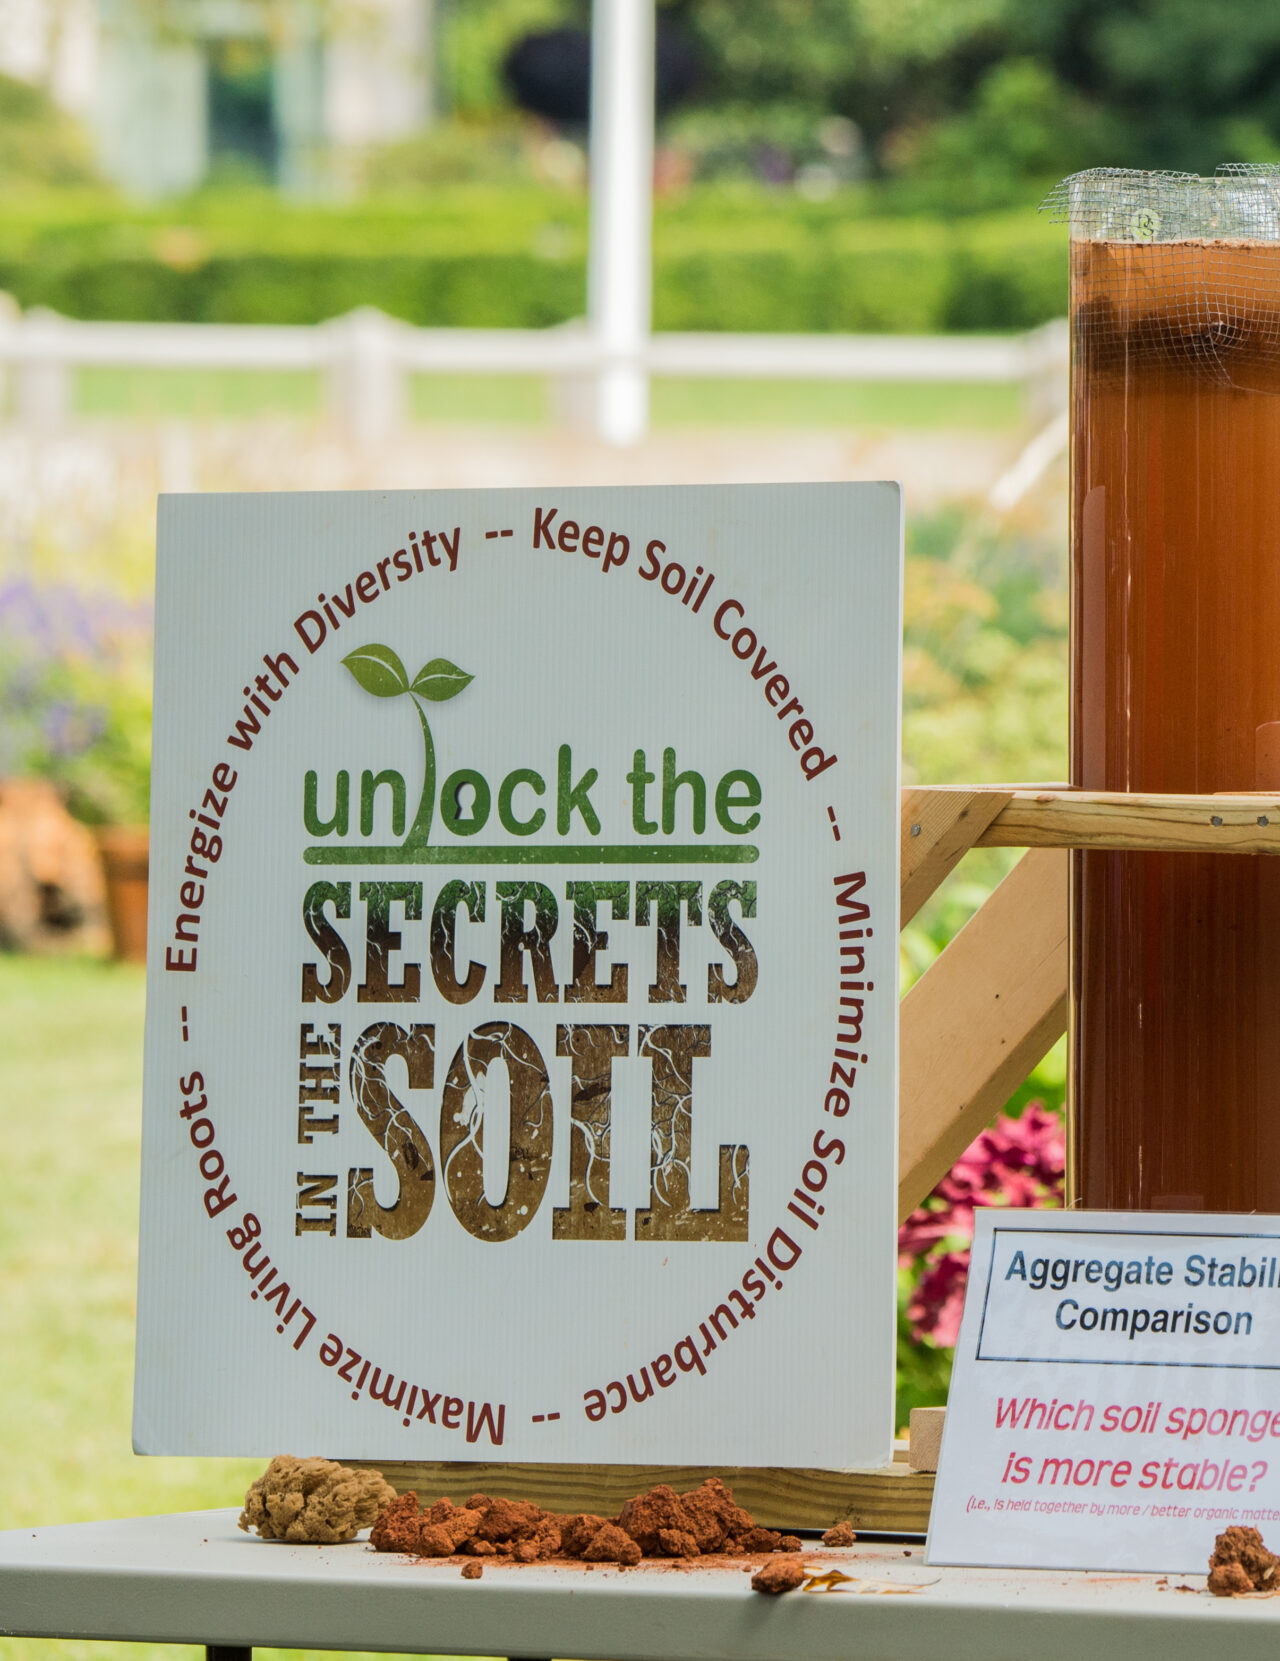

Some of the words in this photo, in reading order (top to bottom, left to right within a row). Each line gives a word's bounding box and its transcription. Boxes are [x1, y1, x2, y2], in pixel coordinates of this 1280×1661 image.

[532, 507, 630, 573] Keep
[638, 540, 715, 613] Soil
[713, 599, 838, 782] Covered
[166, 762, 237, 971] Energize
[227, 651, 299, 750] with
[294, 527, 461, 653] Diversity
[626, 746, 763, 836] the
[301, 879, 759, 1005] SECRETS
[823, 871, 874, 1119] Minimize
[297, 1022, 343, 1144] THE
[347, 1020, 750, 1243] SOIL
[179, 1071, 238, 1218] Roots
[787, 1129, 846, 1231] Soil
[295, 1171, 339, 1237] IN
[226, 1212, 317, 1351] Living
[583, 1228, 803, 1422] Disturbance
[1004, 1250, 1174, 1292] Aggregate
[1055, 1298, 1253, 1340] Comparison
[319, 1333, 506, 1446] Maximize
[995, 1397, 1095, 1432] Which
[1099, 1401, 1162, 1435] soil
[966, 1495, 991, 1513] (i.e.,
[993, 1498, 1004, 1511] is
[1006, 1499, 1032, 1512] held
[1034, 1500, 1087, 1516] together
[1089, 1502, 1105, 1516] by
[1107, 1505, 1141, 1516] more
[1150, 1504, 1191, 1518] better
[1193, 1506, 1239, 1521] organic
[1001, 1451, 1034, 1484] is
[1037, 1456, 1132, 1488] more
[1138, 1458, 1268, 1492] stable?
